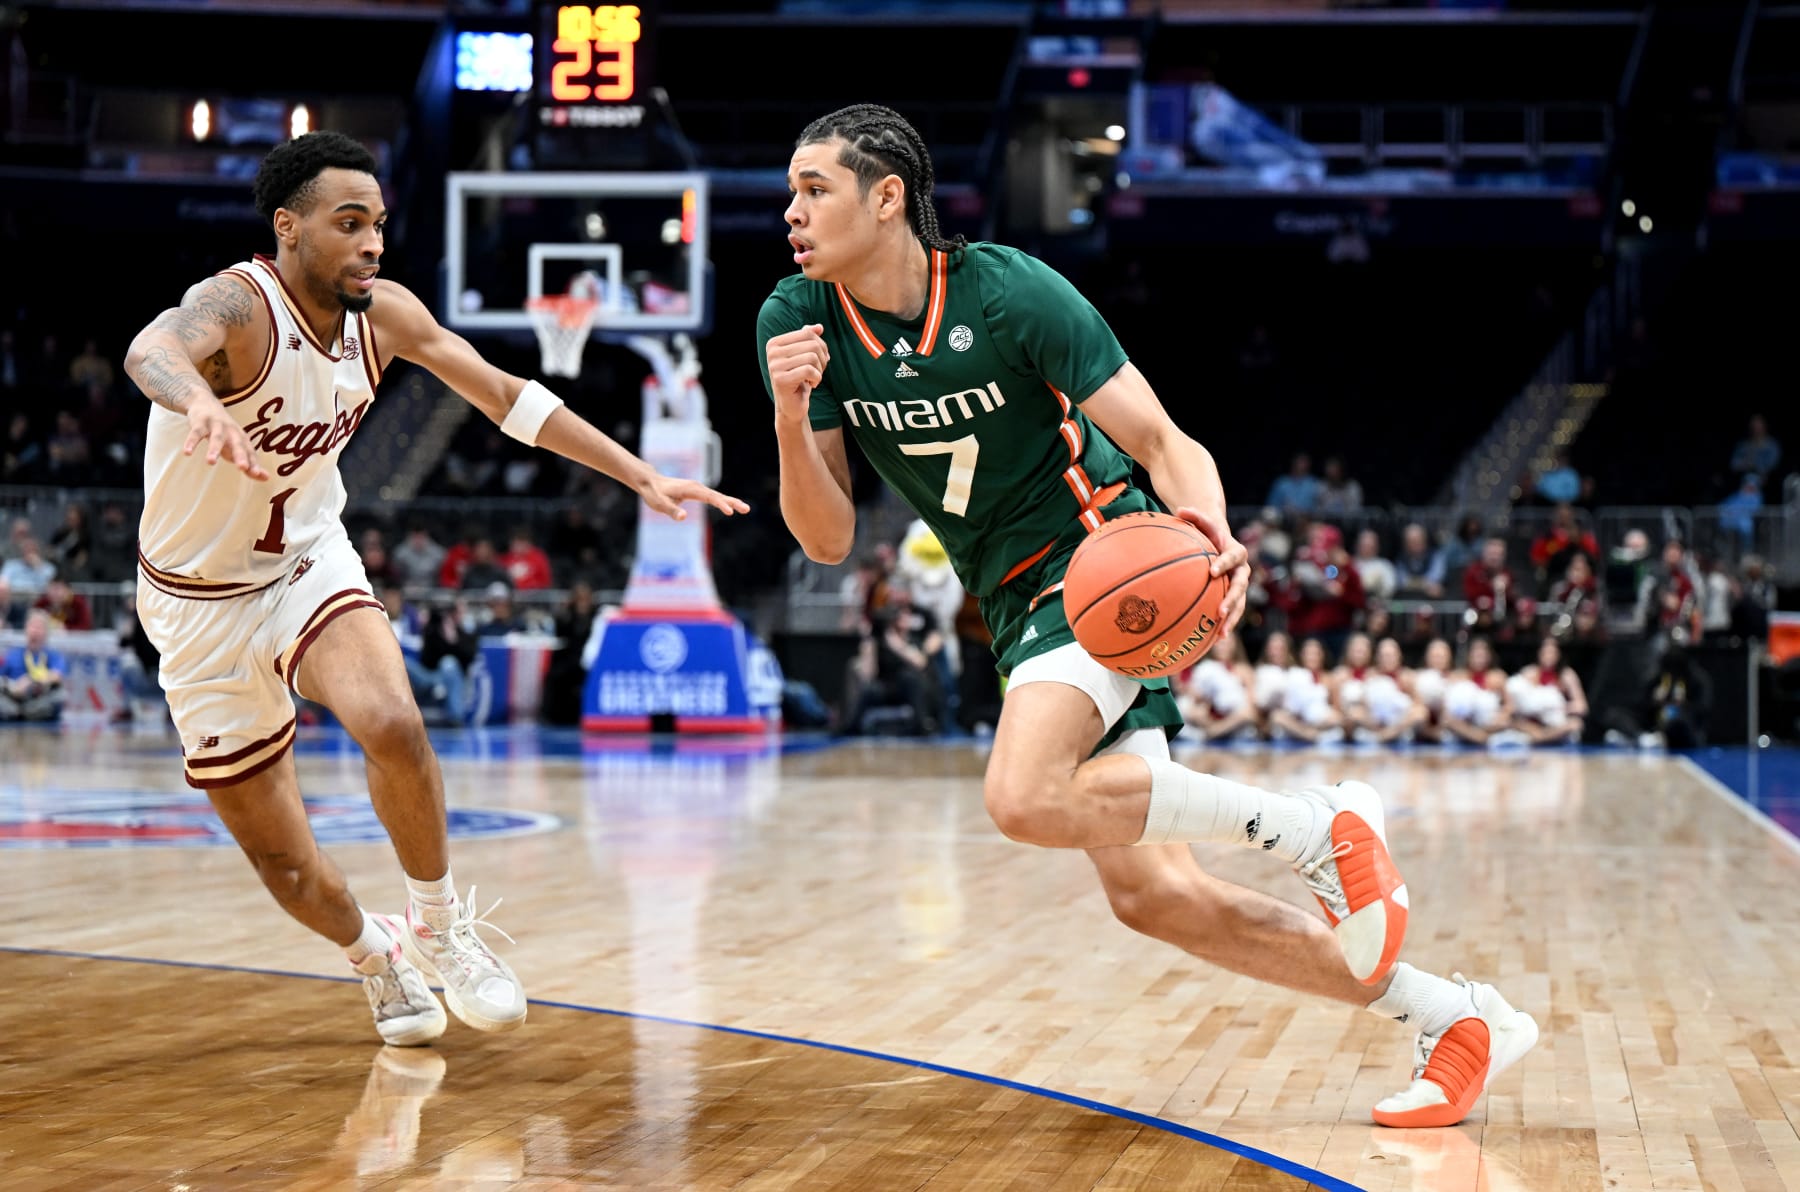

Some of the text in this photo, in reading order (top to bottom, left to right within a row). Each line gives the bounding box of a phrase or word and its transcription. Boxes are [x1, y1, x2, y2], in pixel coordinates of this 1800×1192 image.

[552, 39, 634, 101] 23
[895, 370, 919, 378] adidas
[898, 433, 980, 518] 7
[253, 487, 299, 555] 1
